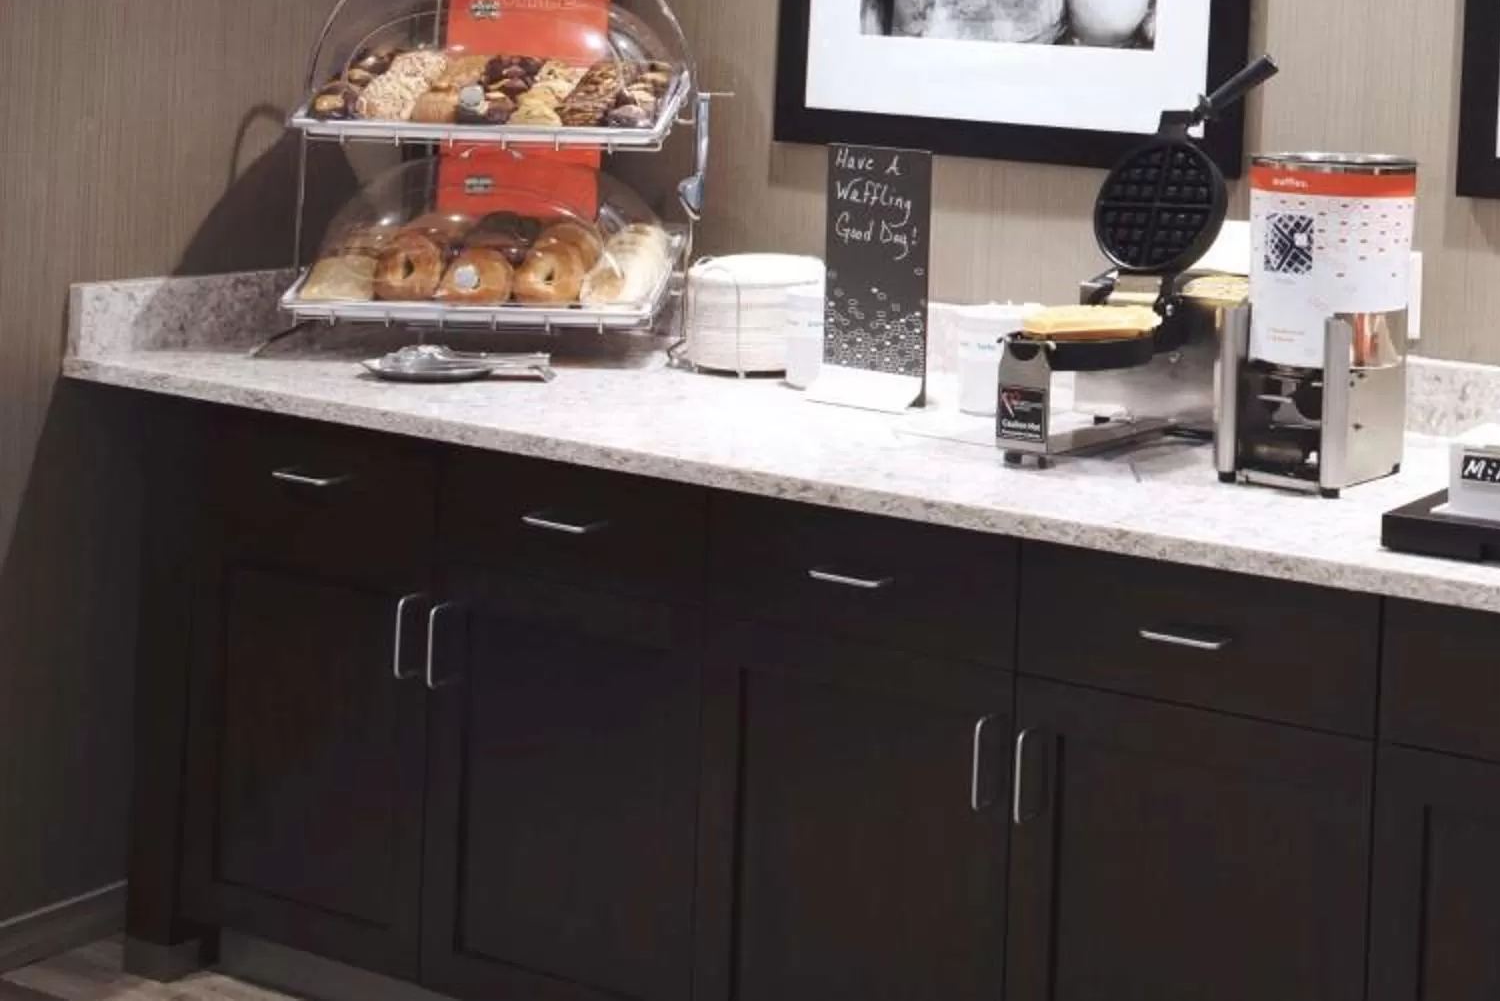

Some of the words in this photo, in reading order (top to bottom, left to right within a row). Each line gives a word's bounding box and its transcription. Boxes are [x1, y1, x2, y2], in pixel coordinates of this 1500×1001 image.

[835, 147, 874, 170] Have
[885, 155, 903, 176] A
[836, 178, 912, 228] Waffling
[835, 211, 875, 245] Good
